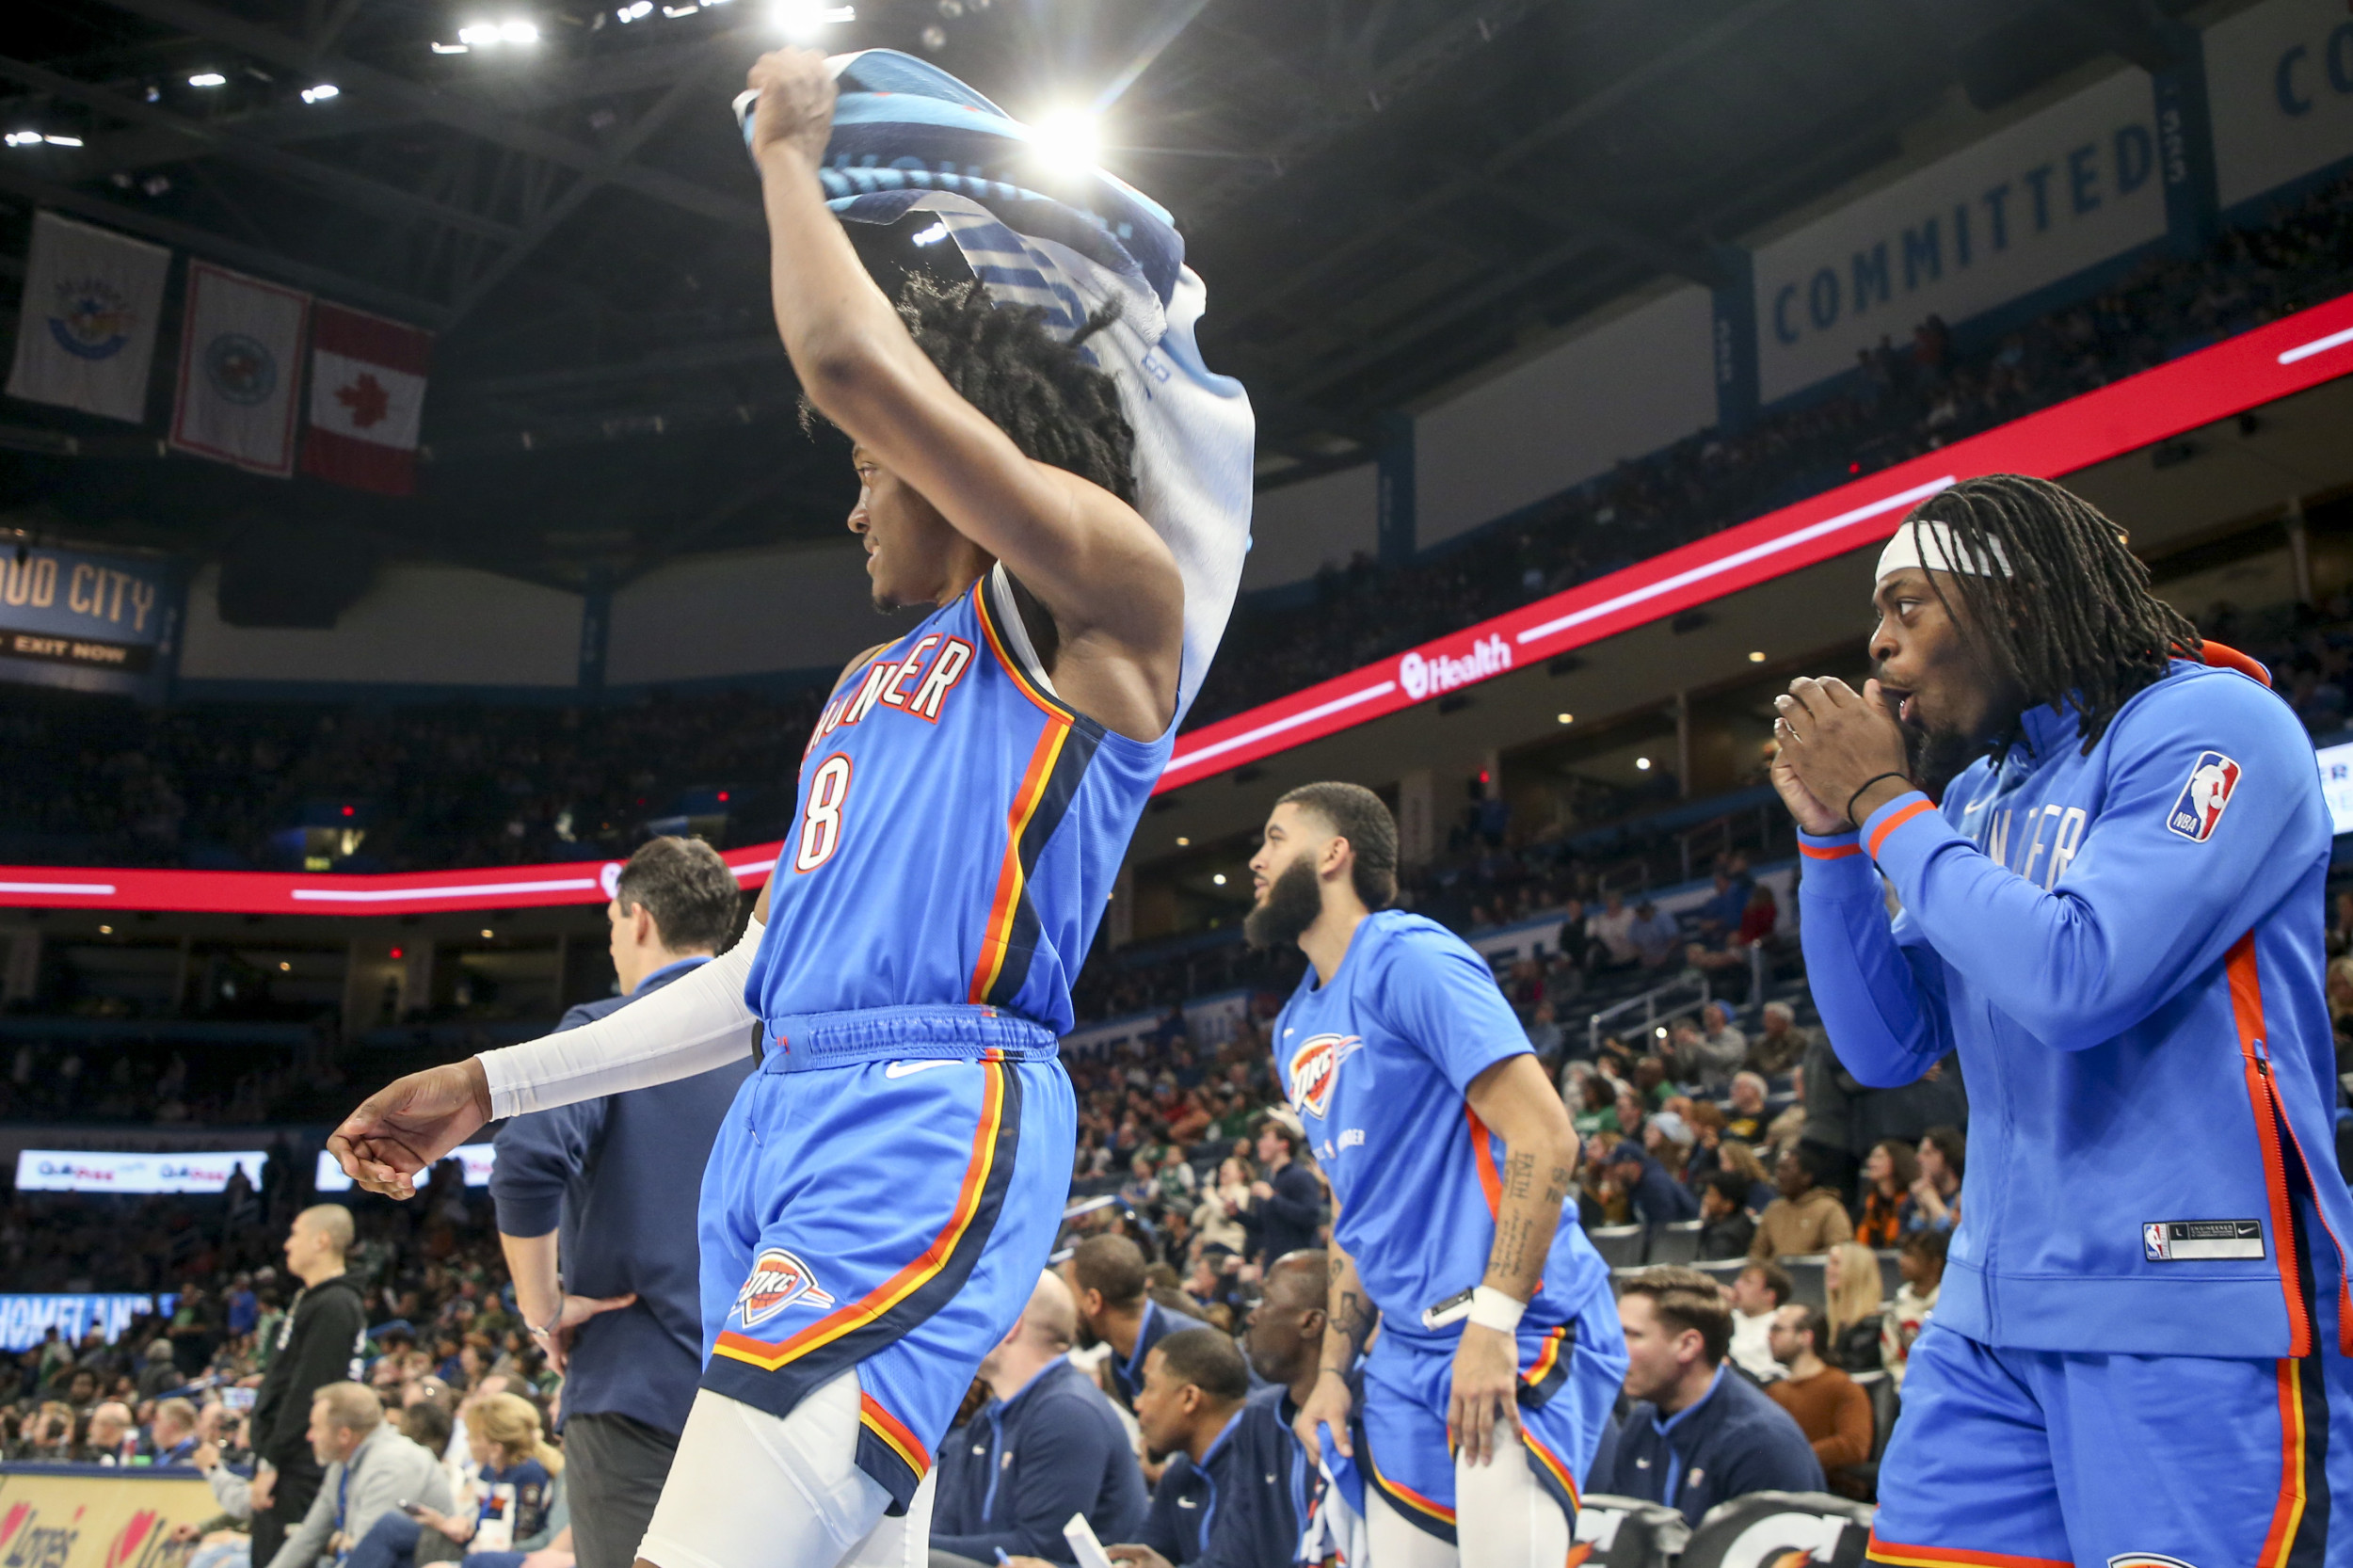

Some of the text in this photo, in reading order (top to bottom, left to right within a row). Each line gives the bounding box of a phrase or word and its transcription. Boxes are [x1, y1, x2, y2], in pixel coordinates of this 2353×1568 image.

[1772, 123, 2153, 345] COMMITTED
[0, 556, 58, 609] UD
[69, 564, 155, 633] CITY
[13, 634, 127, 664] EXIT NOW
[1428, 632, 1513, 695] Health
[794, 751, 854, 874] 8
[2172, 810, 2199, 834] NBA
[1292, 1045, 1333, 1115] OKC
[738, 1270, 798, 1304] OKC
